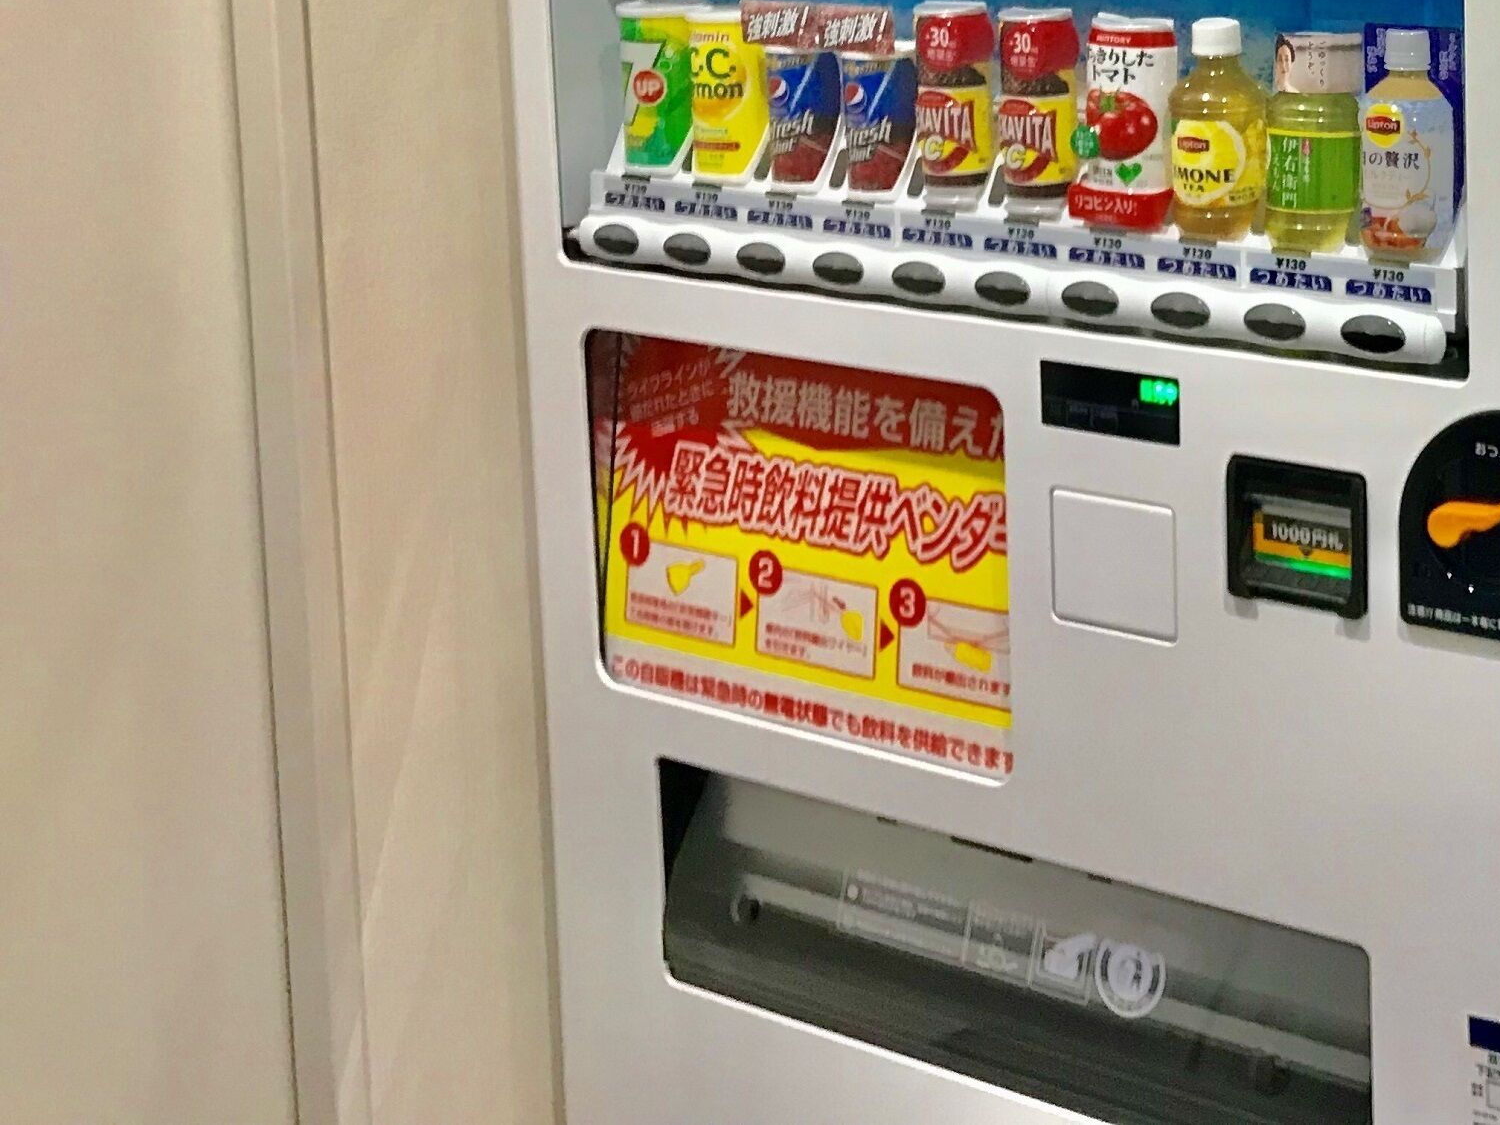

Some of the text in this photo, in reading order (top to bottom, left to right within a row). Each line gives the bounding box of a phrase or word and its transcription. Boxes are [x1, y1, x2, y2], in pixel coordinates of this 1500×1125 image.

[1092, 67, 1136, 85] トマト
[629, 529, 641, 558] 1
[757, 558, 774, 588] 2
[900, 586, 916, 616] 3
